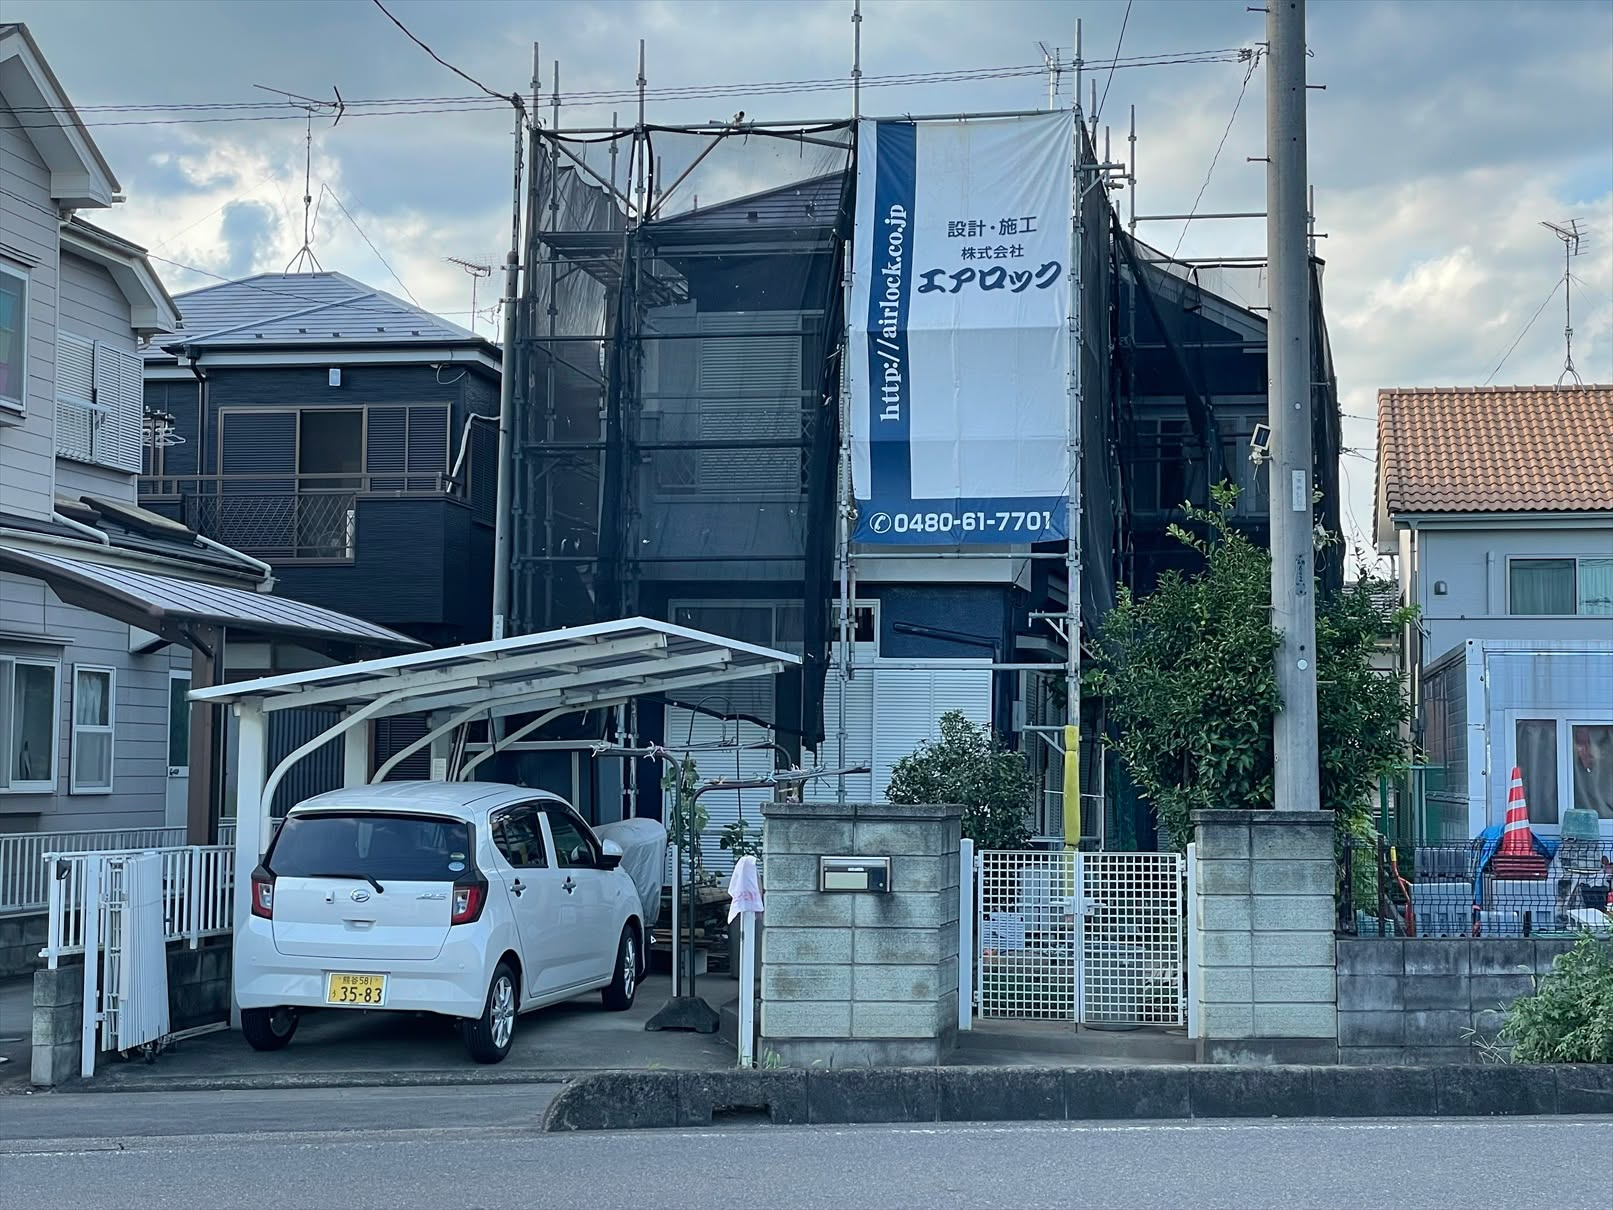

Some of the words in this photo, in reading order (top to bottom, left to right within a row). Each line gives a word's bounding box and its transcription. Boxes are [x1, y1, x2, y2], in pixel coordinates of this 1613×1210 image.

[947, 216, 1038, 238] 設計・施工
[961, 243, 1025, 260] 株式会社
[917, 260, 1062, 294] エアロック
[877, 204, 907, 422] http://airlock.co.jp
[894, 511, 1051, 533] 0480-61-7701
[340, 986, 382, 1003] 35-83
